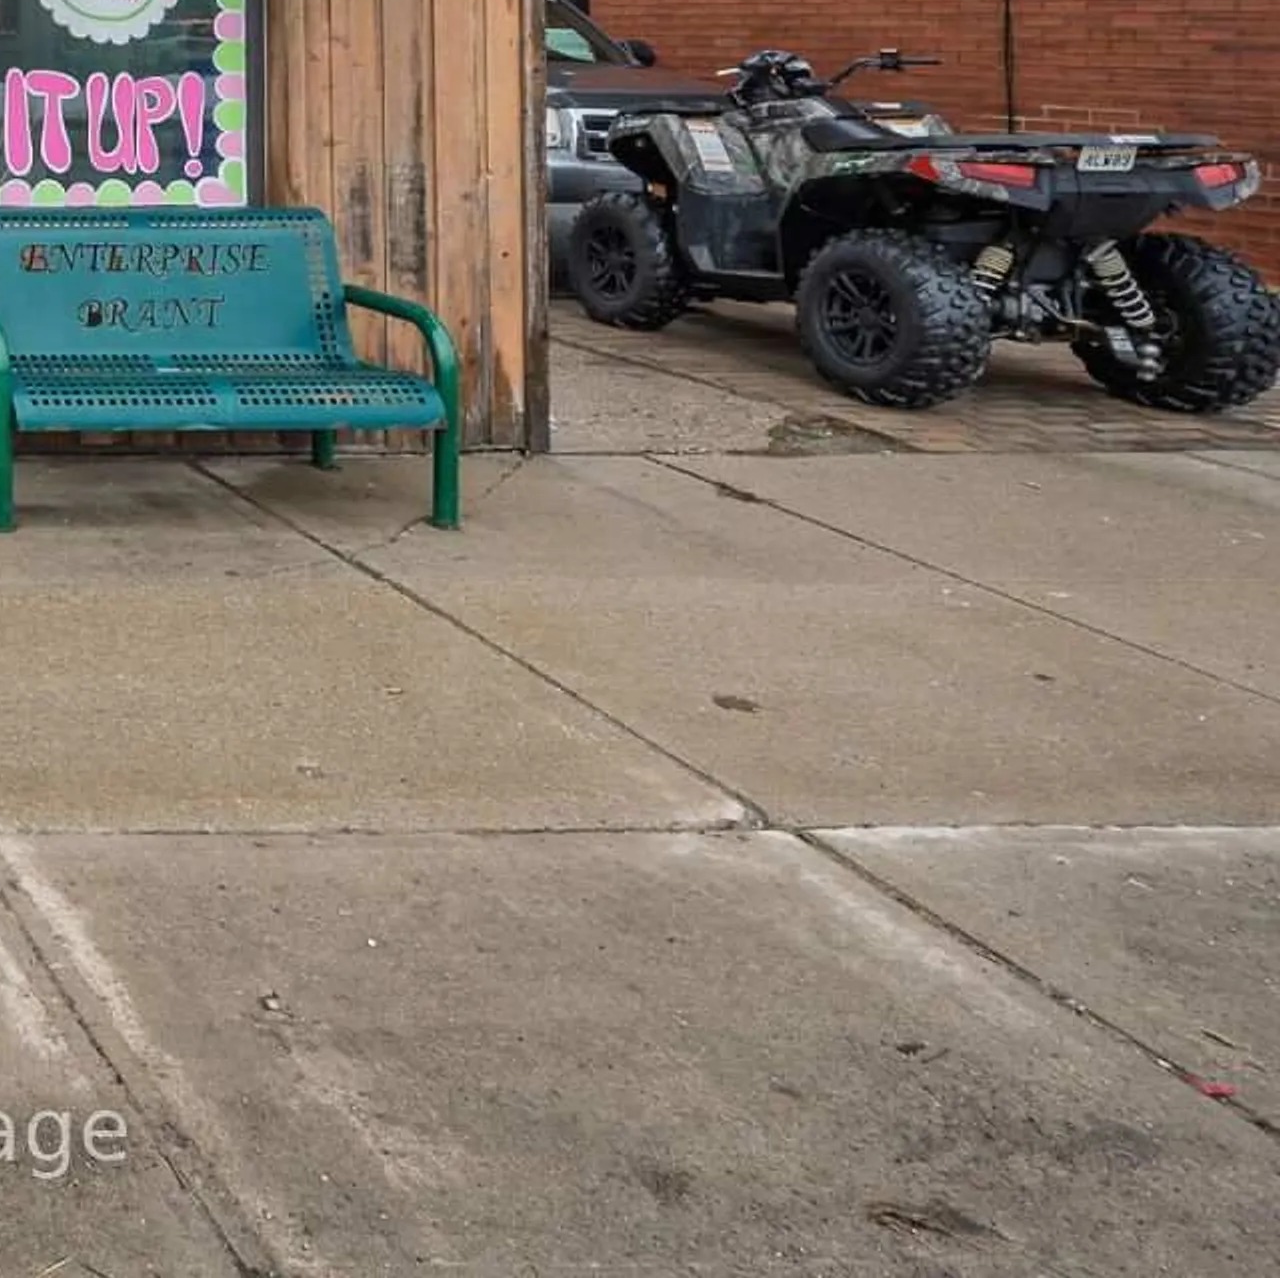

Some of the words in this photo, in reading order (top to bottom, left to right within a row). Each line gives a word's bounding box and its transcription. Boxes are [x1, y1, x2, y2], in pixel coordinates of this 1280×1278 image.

[4, 67, 81, 177] IT
[85, 71, 206, 178] UP!
[22, 241, 271, 277] ENTERPRISE
[78, 294, 228, 330] BRANT
